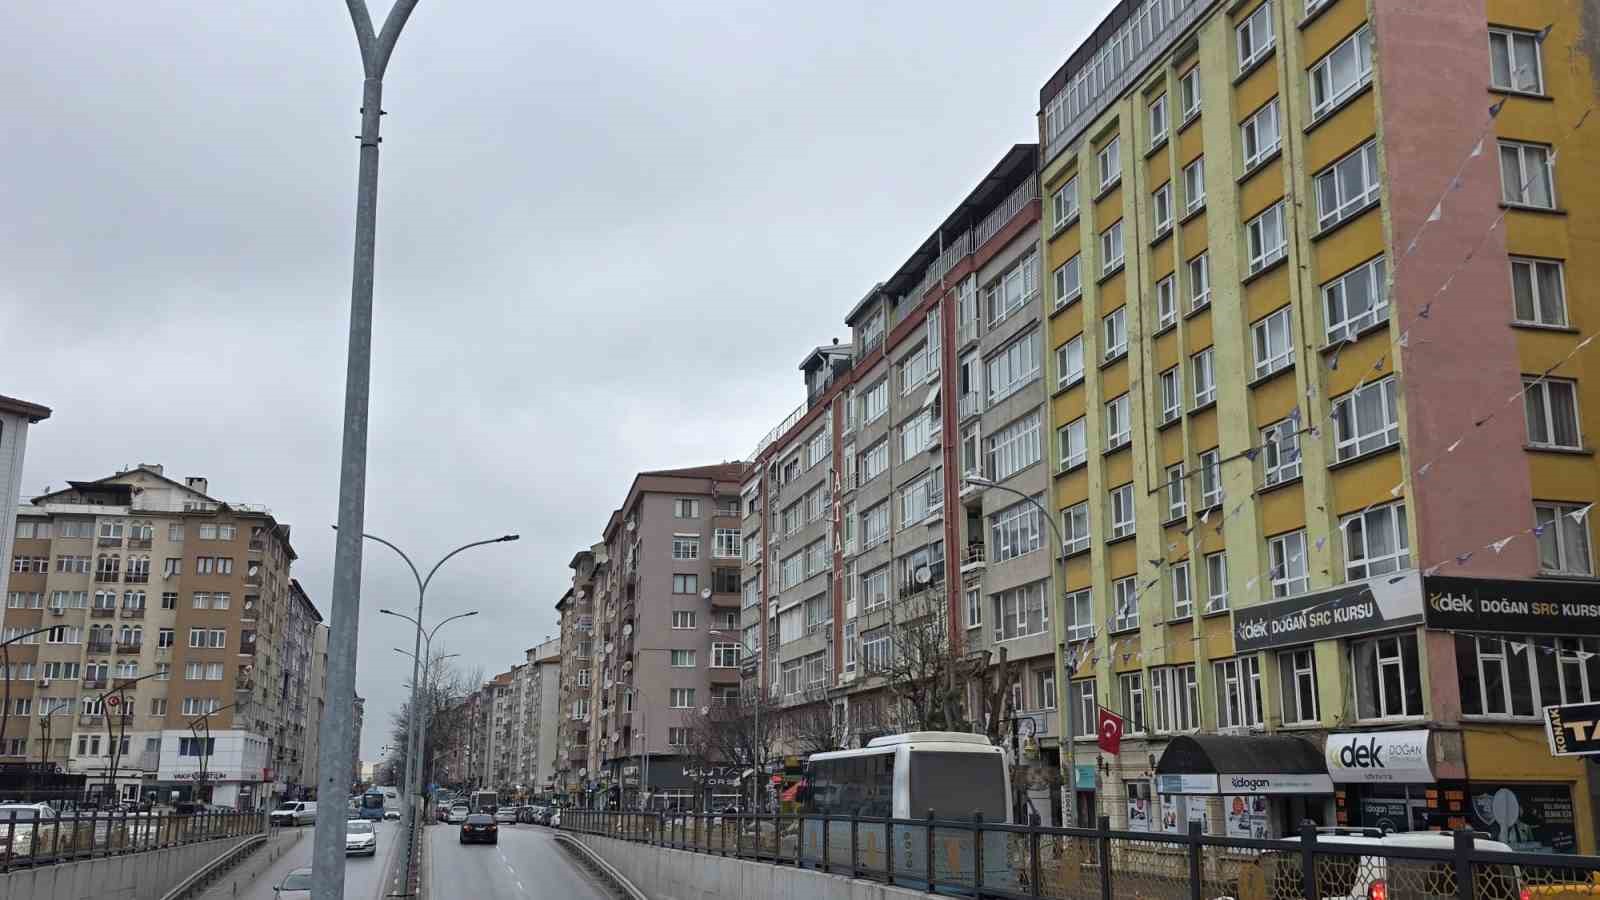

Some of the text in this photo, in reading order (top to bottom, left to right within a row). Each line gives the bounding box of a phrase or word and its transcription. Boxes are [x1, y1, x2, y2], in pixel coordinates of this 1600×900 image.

[1245, 617, 1268, 639] dek
[1309, 612, 1331, 627] SRC
[1334, 602, 1373, 623] KURSU
[1440, 593, 1600, 617] dek DOĞAN SRC KURS
[1549, 708, 1568, 753] KONAK
[1340, 737, 1385, 768] dek
